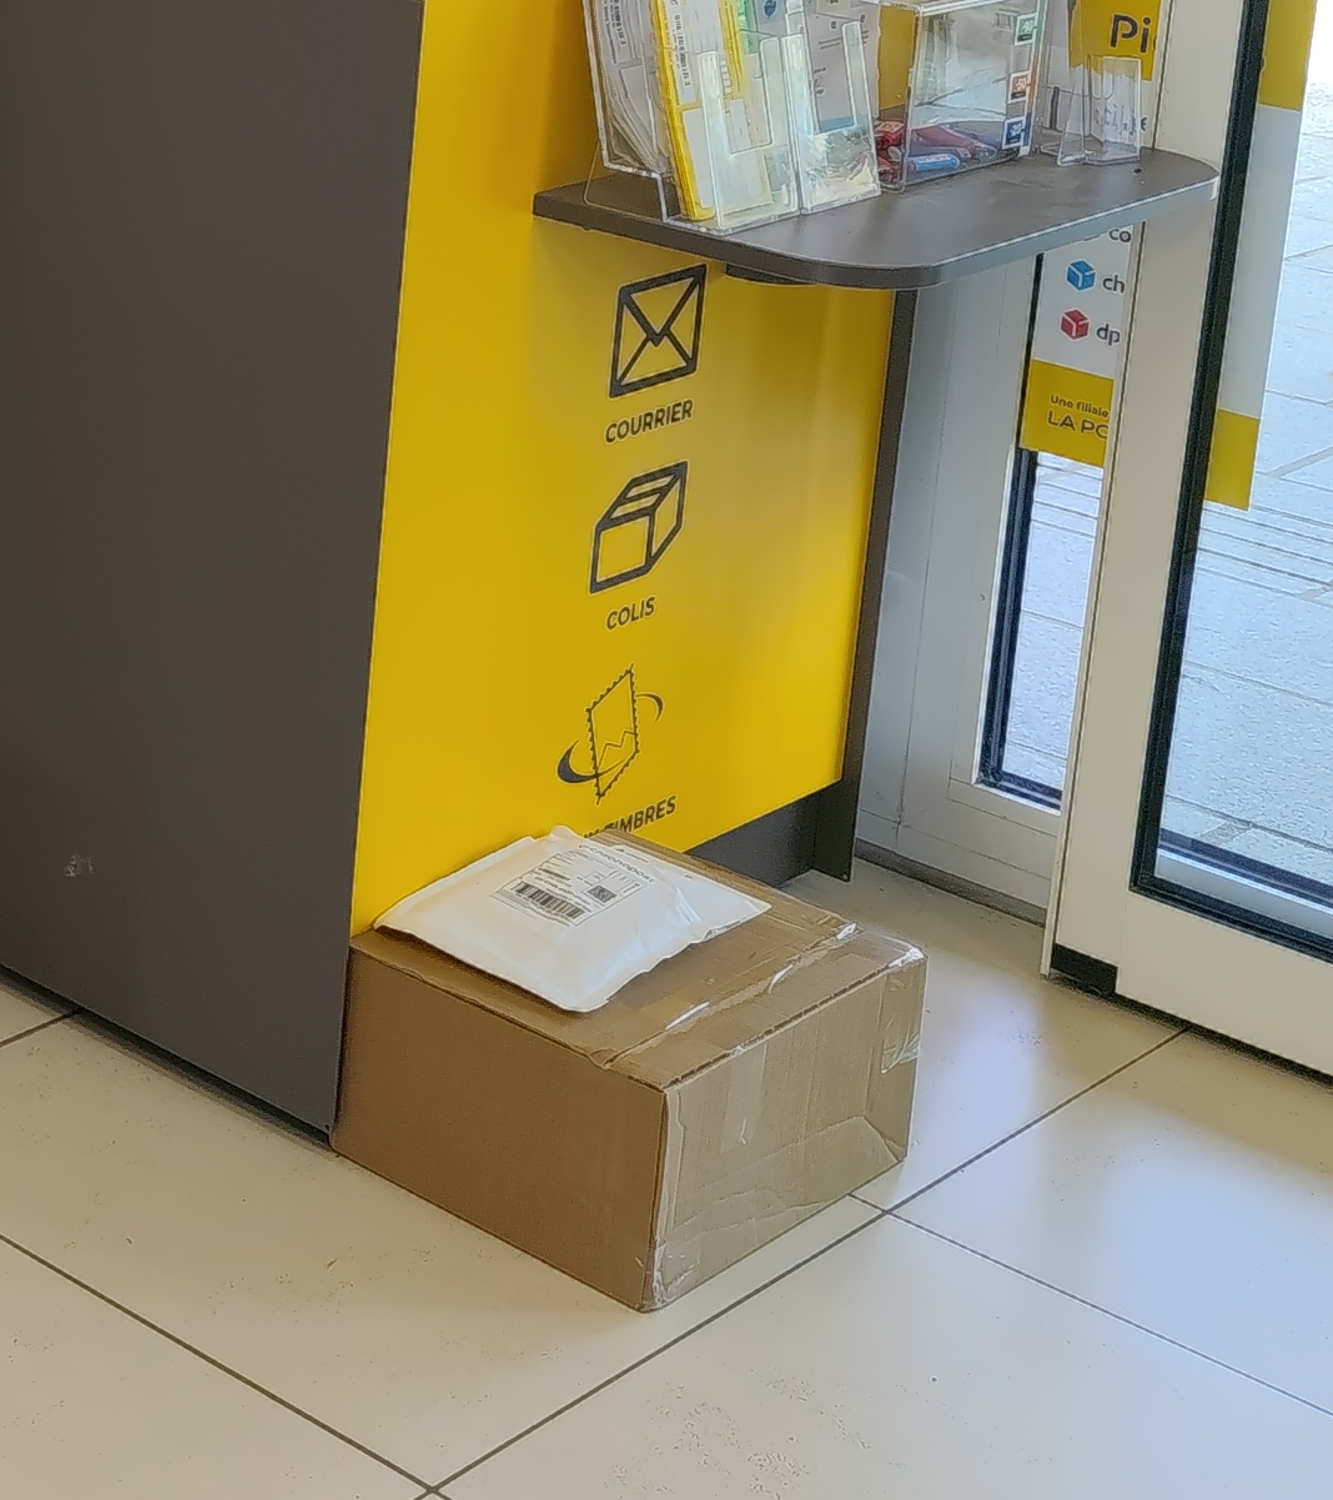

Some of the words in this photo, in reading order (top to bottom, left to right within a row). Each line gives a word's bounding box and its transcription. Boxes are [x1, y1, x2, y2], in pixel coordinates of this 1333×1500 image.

[1050, 394, 1074, 410] Une
[1076, 399, 1110, 418] filiale
[604, 398, 695, 445] COURRIER
[1048, 411, 1076, 432] LA
[605, 595, 657, 631] COLIS
